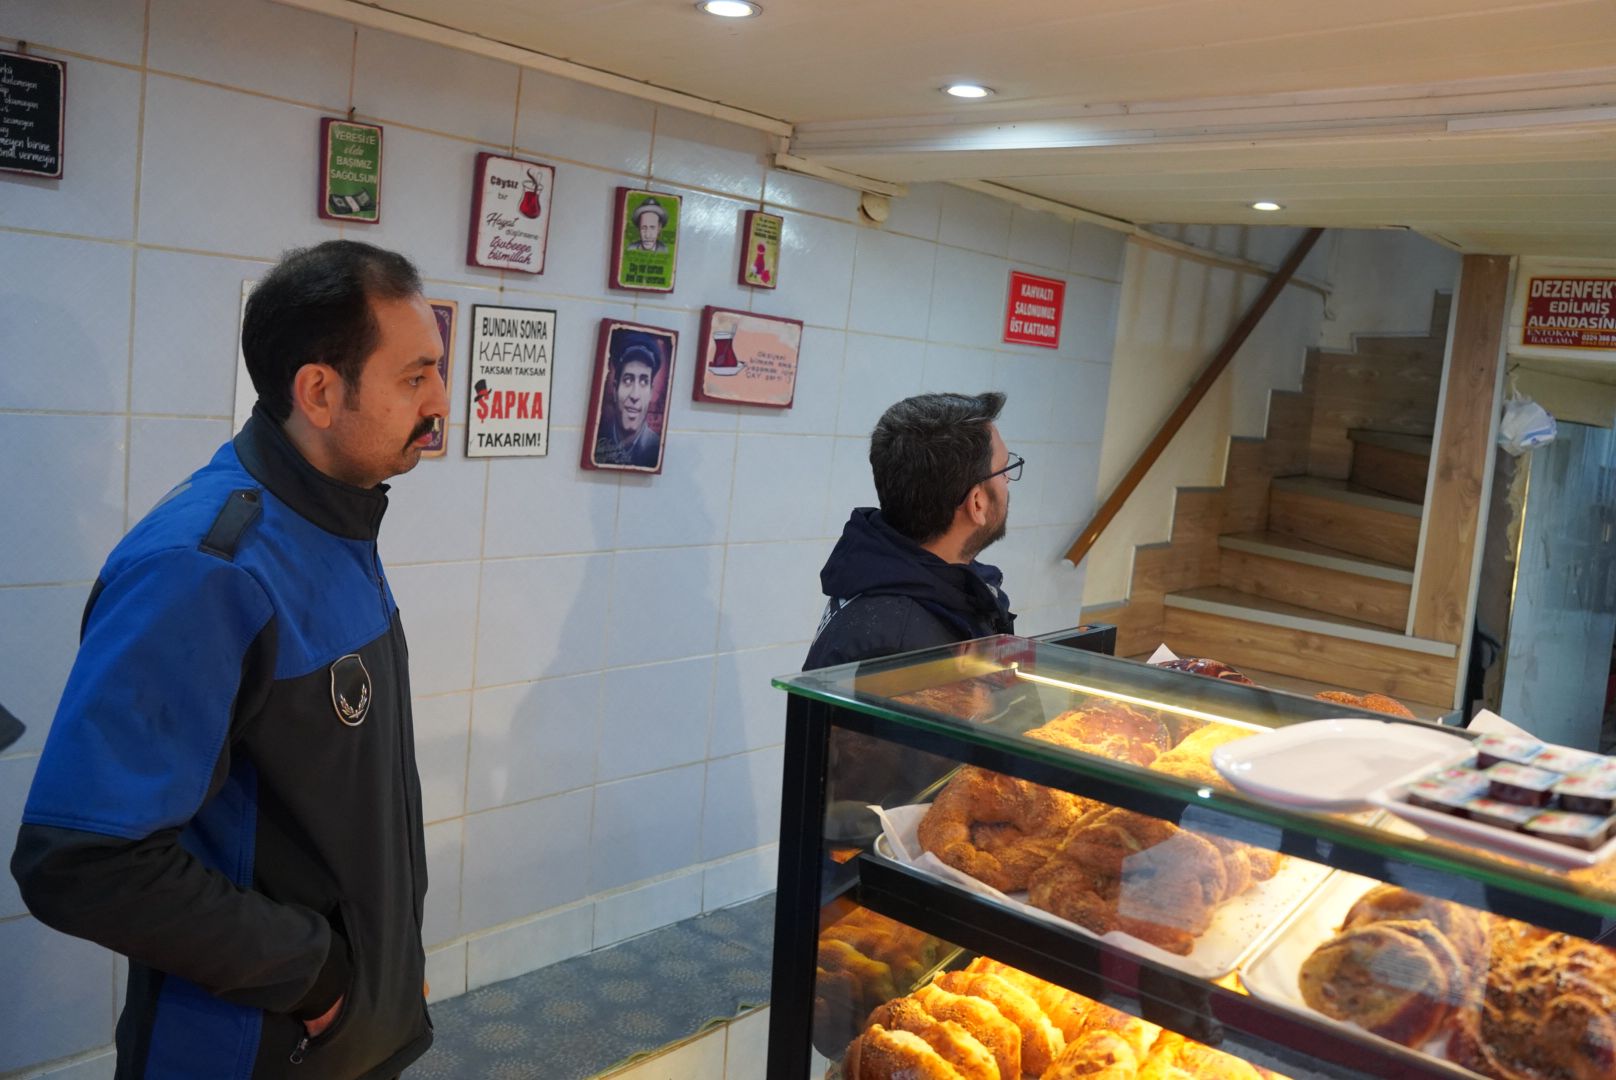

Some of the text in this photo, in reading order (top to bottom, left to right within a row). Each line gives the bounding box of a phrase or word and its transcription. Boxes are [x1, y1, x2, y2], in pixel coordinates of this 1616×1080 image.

[1021, 283, 1054, 301] KAHVALTI
[1015, 301, 1056, 320] SALONUMUZ
[1549, 299, 1611, 318] EDİLMİŞ
[482, 317, 547, 340] BUNDAN SONRA
[1010, 316, 1056, 337] ÜST KATTADIR
[479, 341, 547, 363] KAFAMA
[480, 365, 546, 376] TAKSAM TAKSAM
[476, 389, 543, 423] ŞAPKA
[477, 433, 541, 447] TAKARIM!
